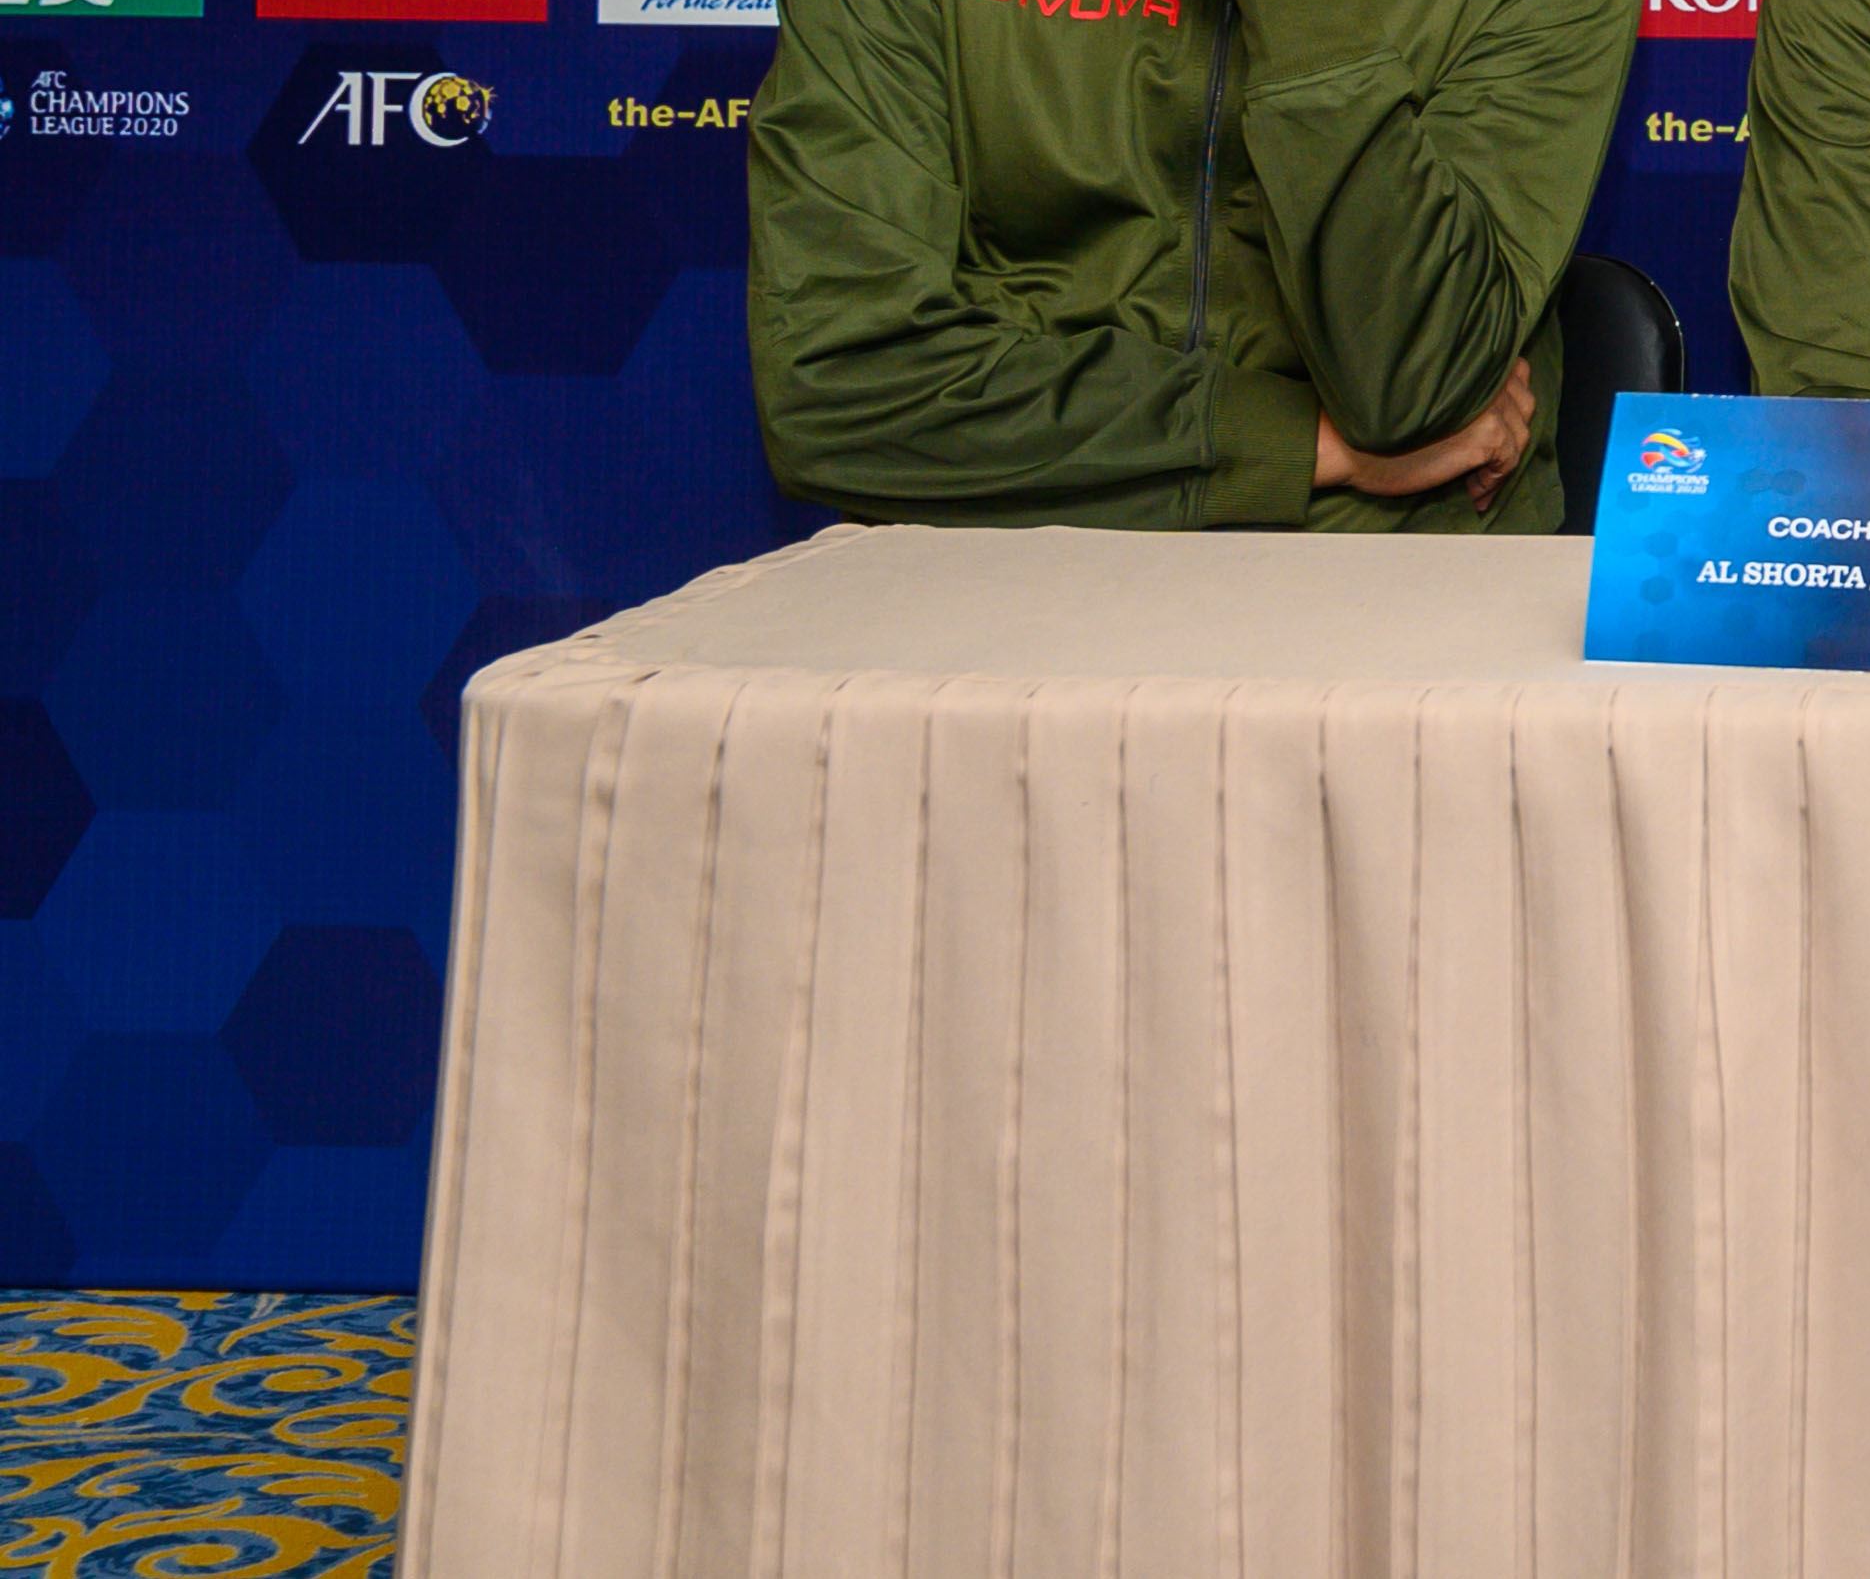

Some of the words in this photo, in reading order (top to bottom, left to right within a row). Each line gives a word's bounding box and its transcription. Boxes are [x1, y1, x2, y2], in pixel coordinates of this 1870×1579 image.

[32, 71, 66, 88] AFC
[31, 90, 189, 115] CHAMPIONS
[299, 71, 480, 147] AFC
[31, 116, 114, 135] LEAGUE
[120, 118, 177, 136] 2020
[1697, 561, 1738, 583] AL
[1743, 562, 1866, 588] SHORTA
